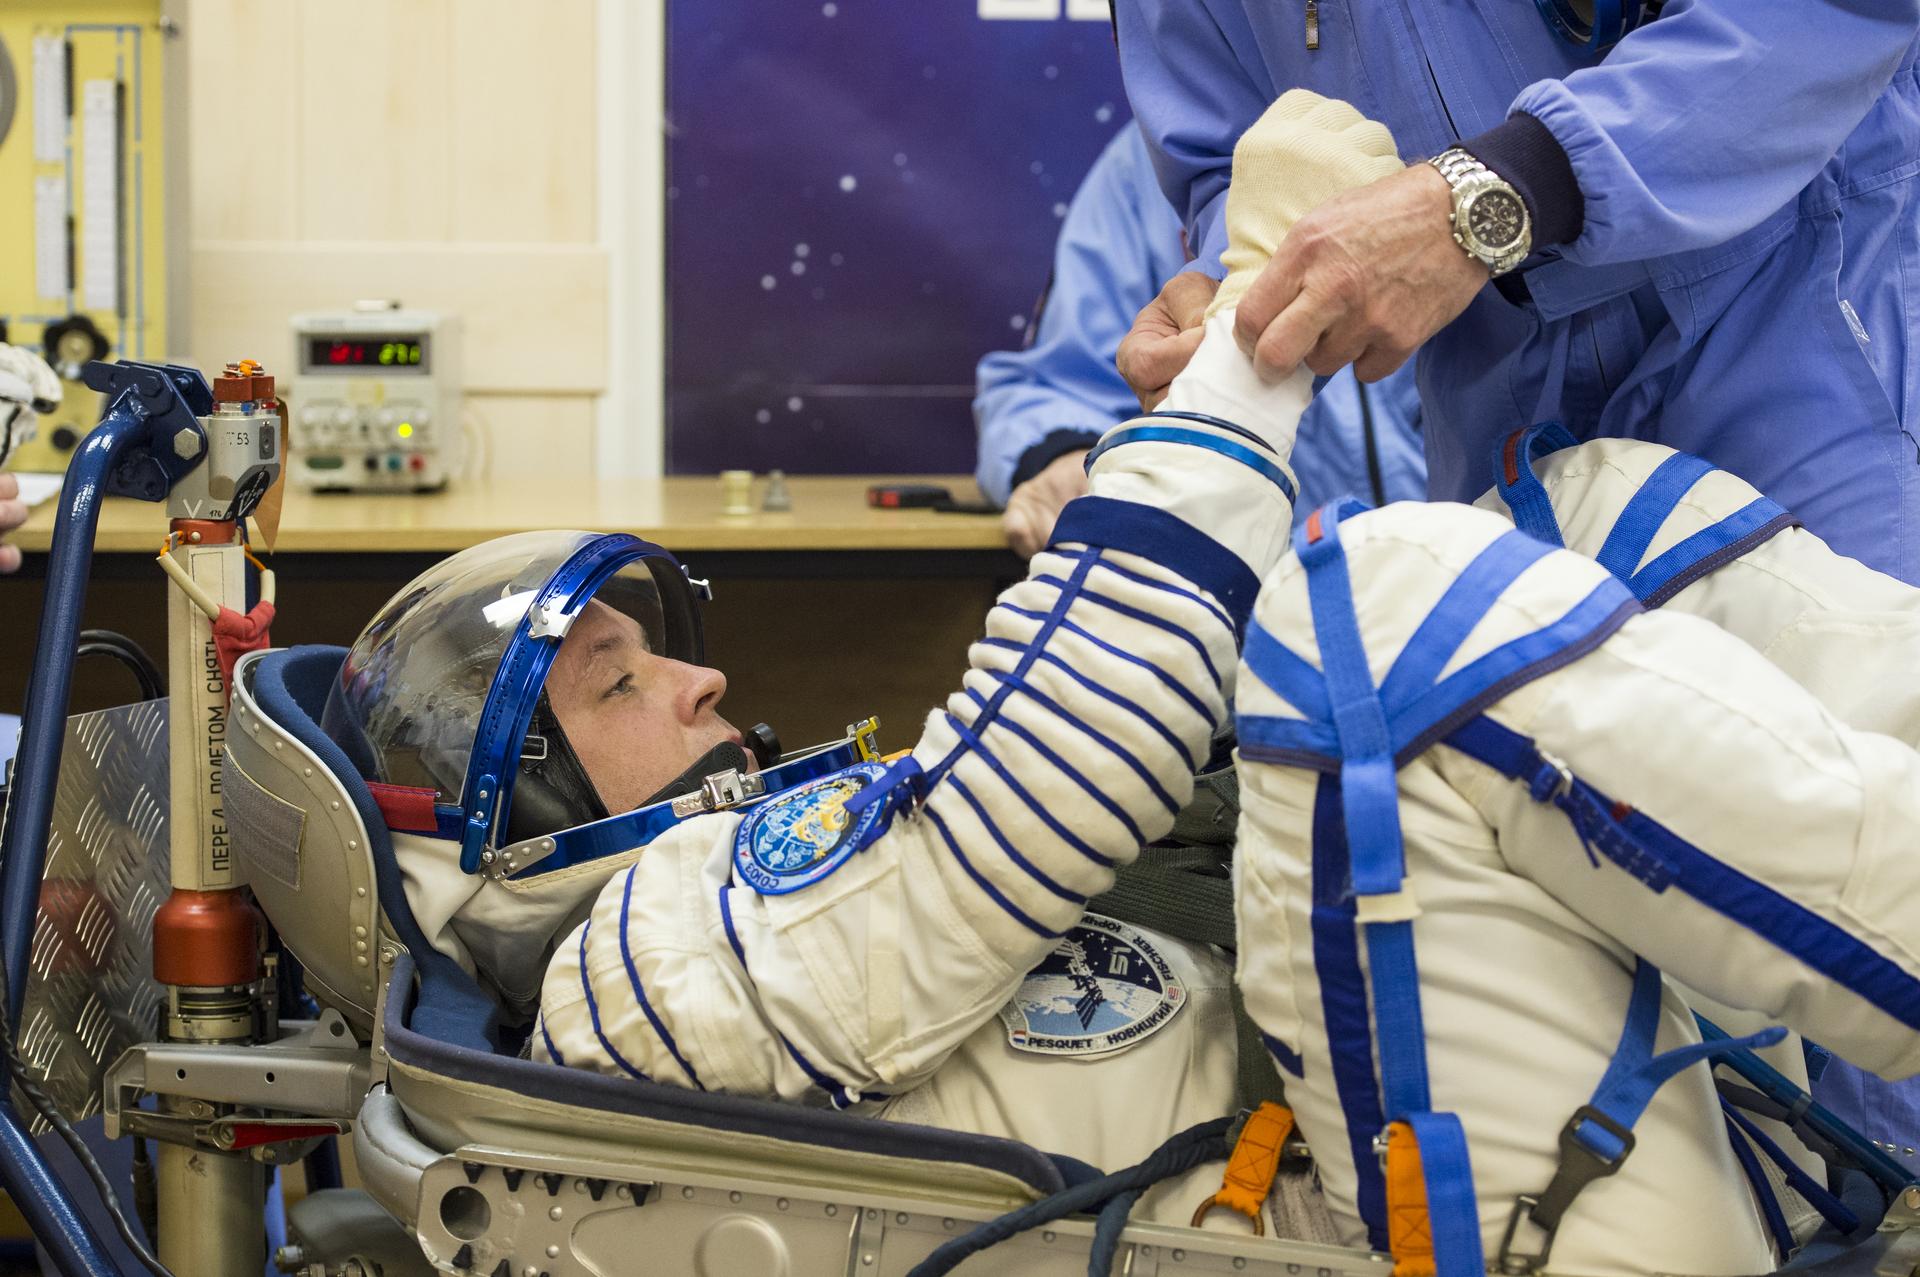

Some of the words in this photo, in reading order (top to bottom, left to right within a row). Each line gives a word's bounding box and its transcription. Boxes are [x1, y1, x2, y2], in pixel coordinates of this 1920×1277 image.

[208, 706, 226, 795] ПОЛЕТОМ
[212, 808, 229, 871] ПЕРЕД
[745, 862, 780, 889] СОЮЗ
[1109, 946, 1132, 976] 51
[1132, 936, 1174, 981] FISCHER
[1028, 1038, 1094, 1049] PESQUET
[1106, 1001, 1174, 1045] НОВИЦКИЙ
